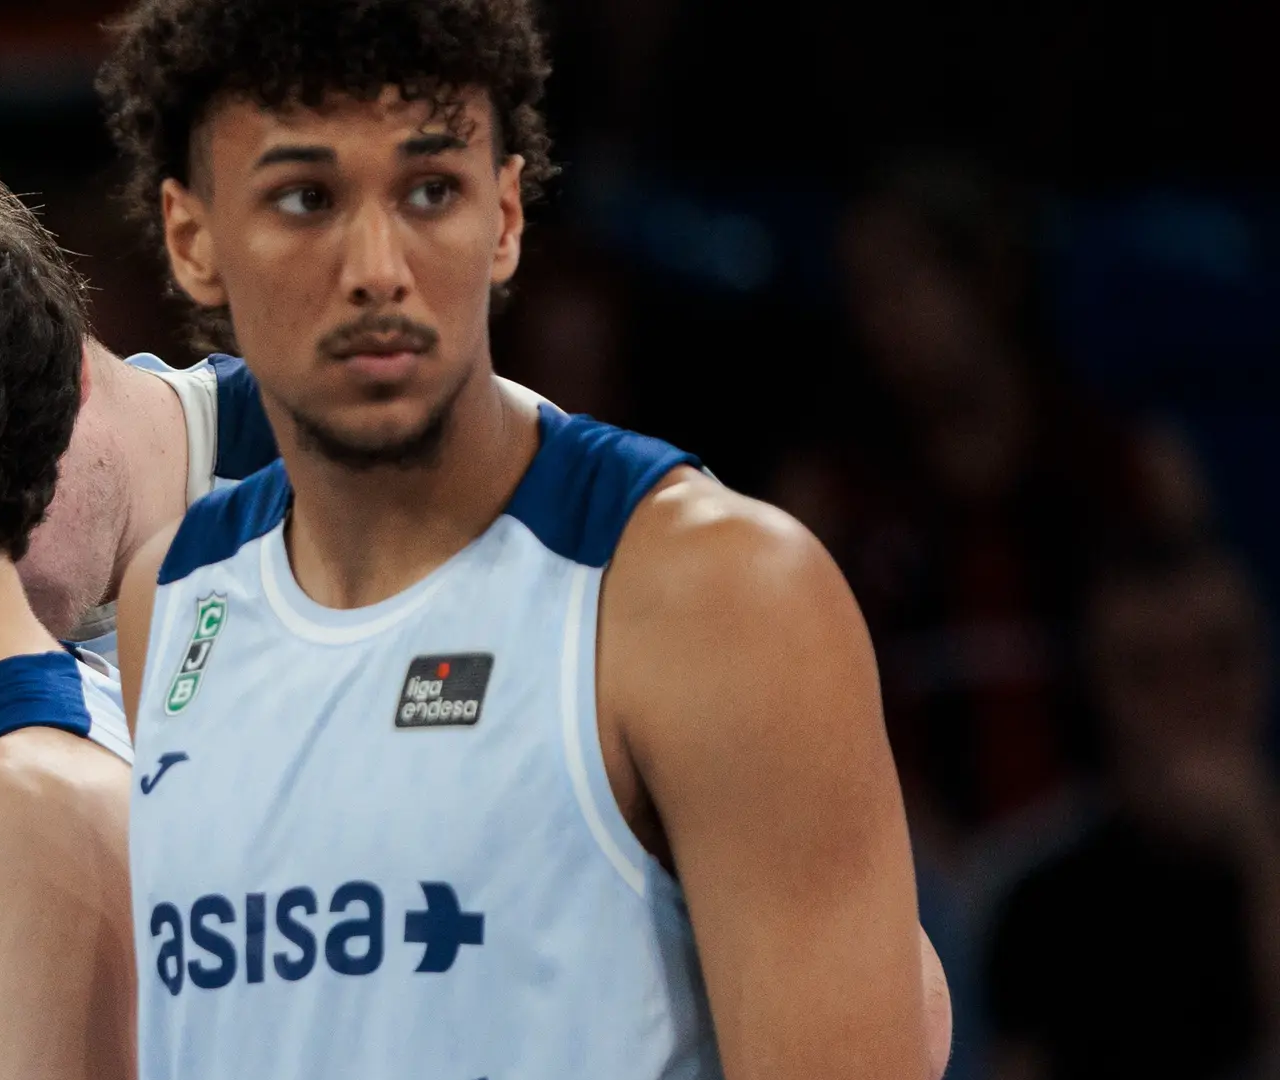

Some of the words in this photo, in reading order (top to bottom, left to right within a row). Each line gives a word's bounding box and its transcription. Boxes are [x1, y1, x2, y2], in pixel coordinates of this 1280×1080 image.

[406, 675, 443, 701] liga
[401, 696, 479, 722] endesa
[150, 880, 385, 996] asisa
